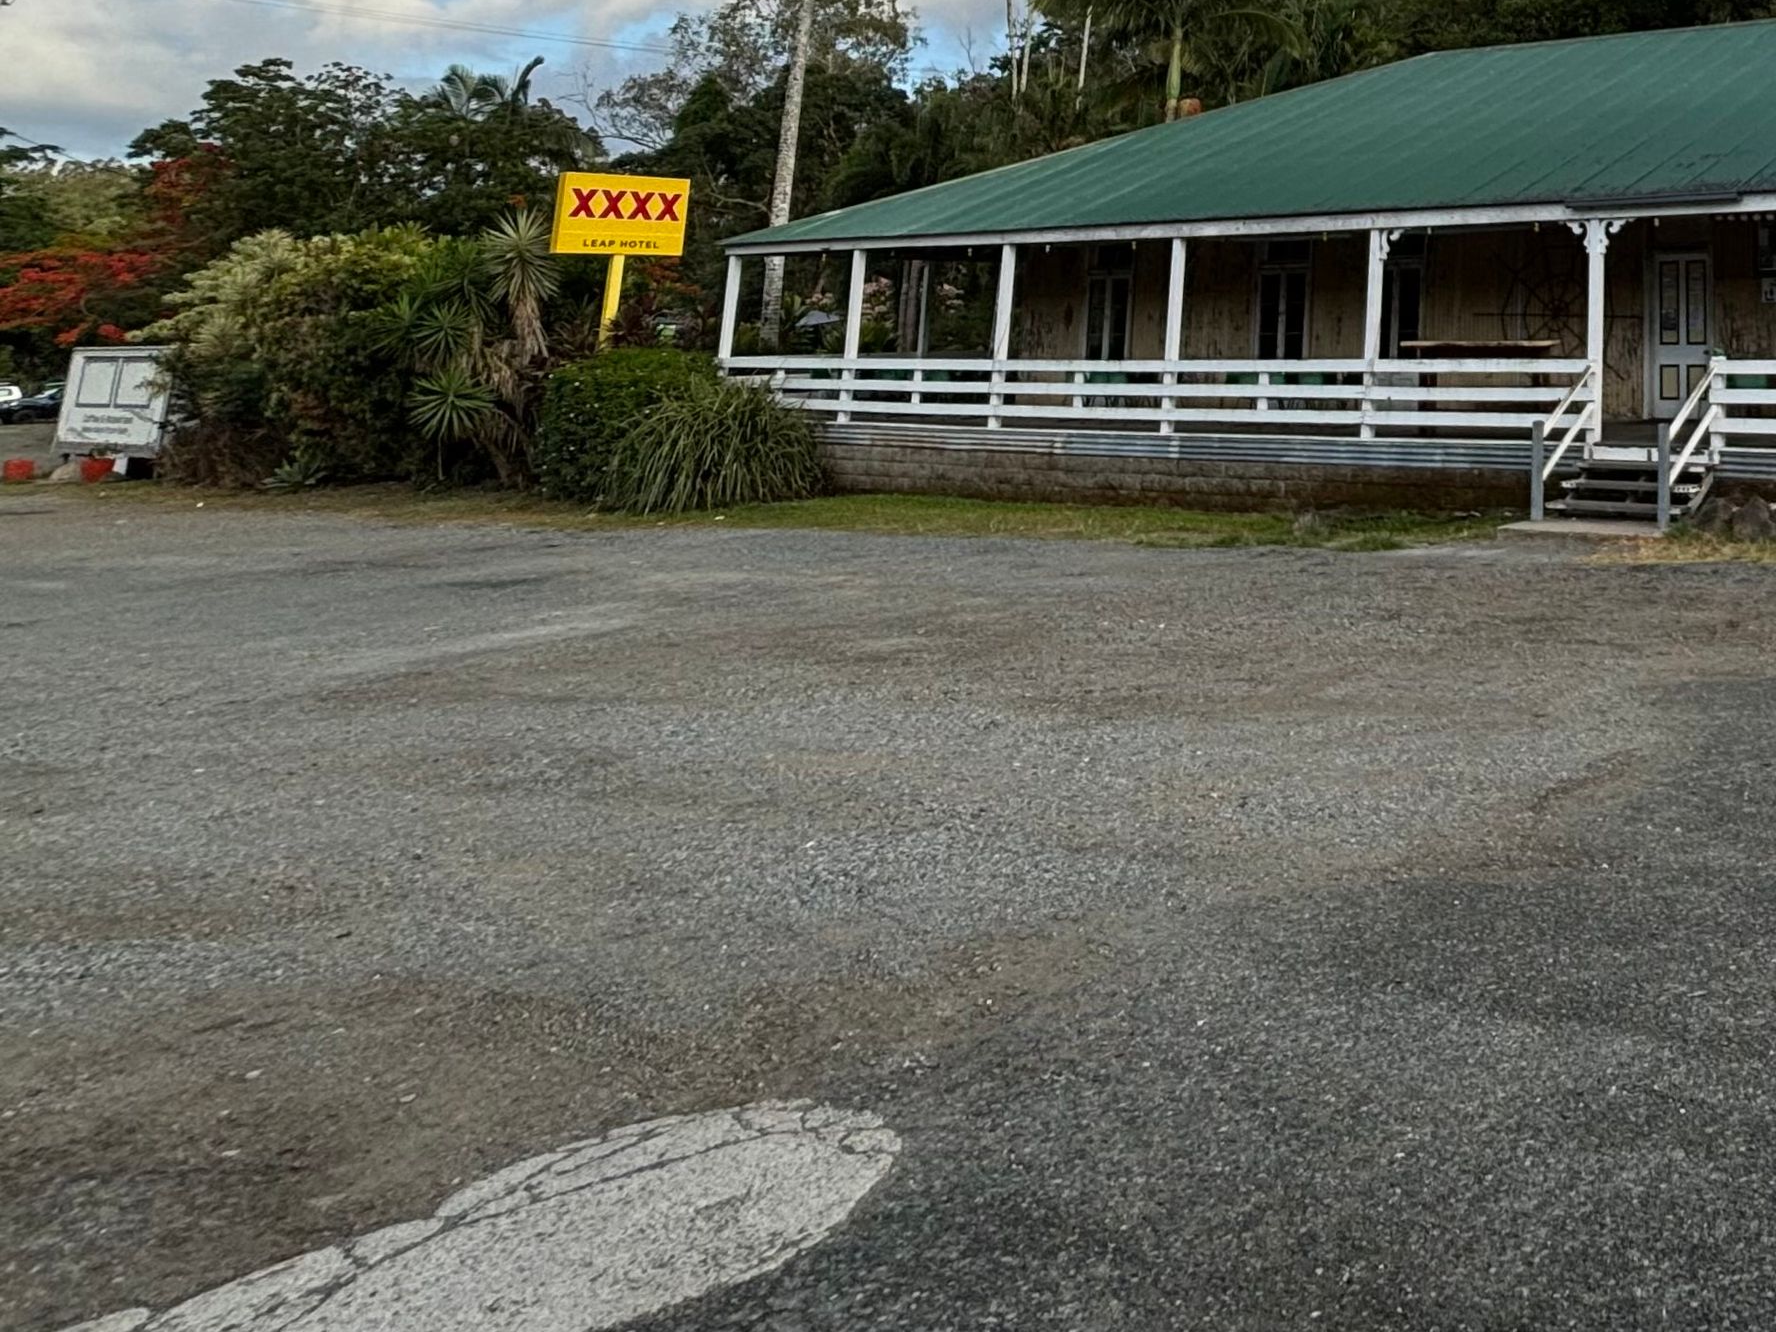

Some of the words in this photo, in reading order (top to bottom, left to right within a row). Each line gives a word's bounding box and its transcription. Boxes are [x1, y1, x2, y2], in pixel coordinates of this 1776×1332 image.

[568, 188, 682, 222] XXXX
[582, 238, 616, 248] LEAP
[619, 239, 660, 250] HOTEL
